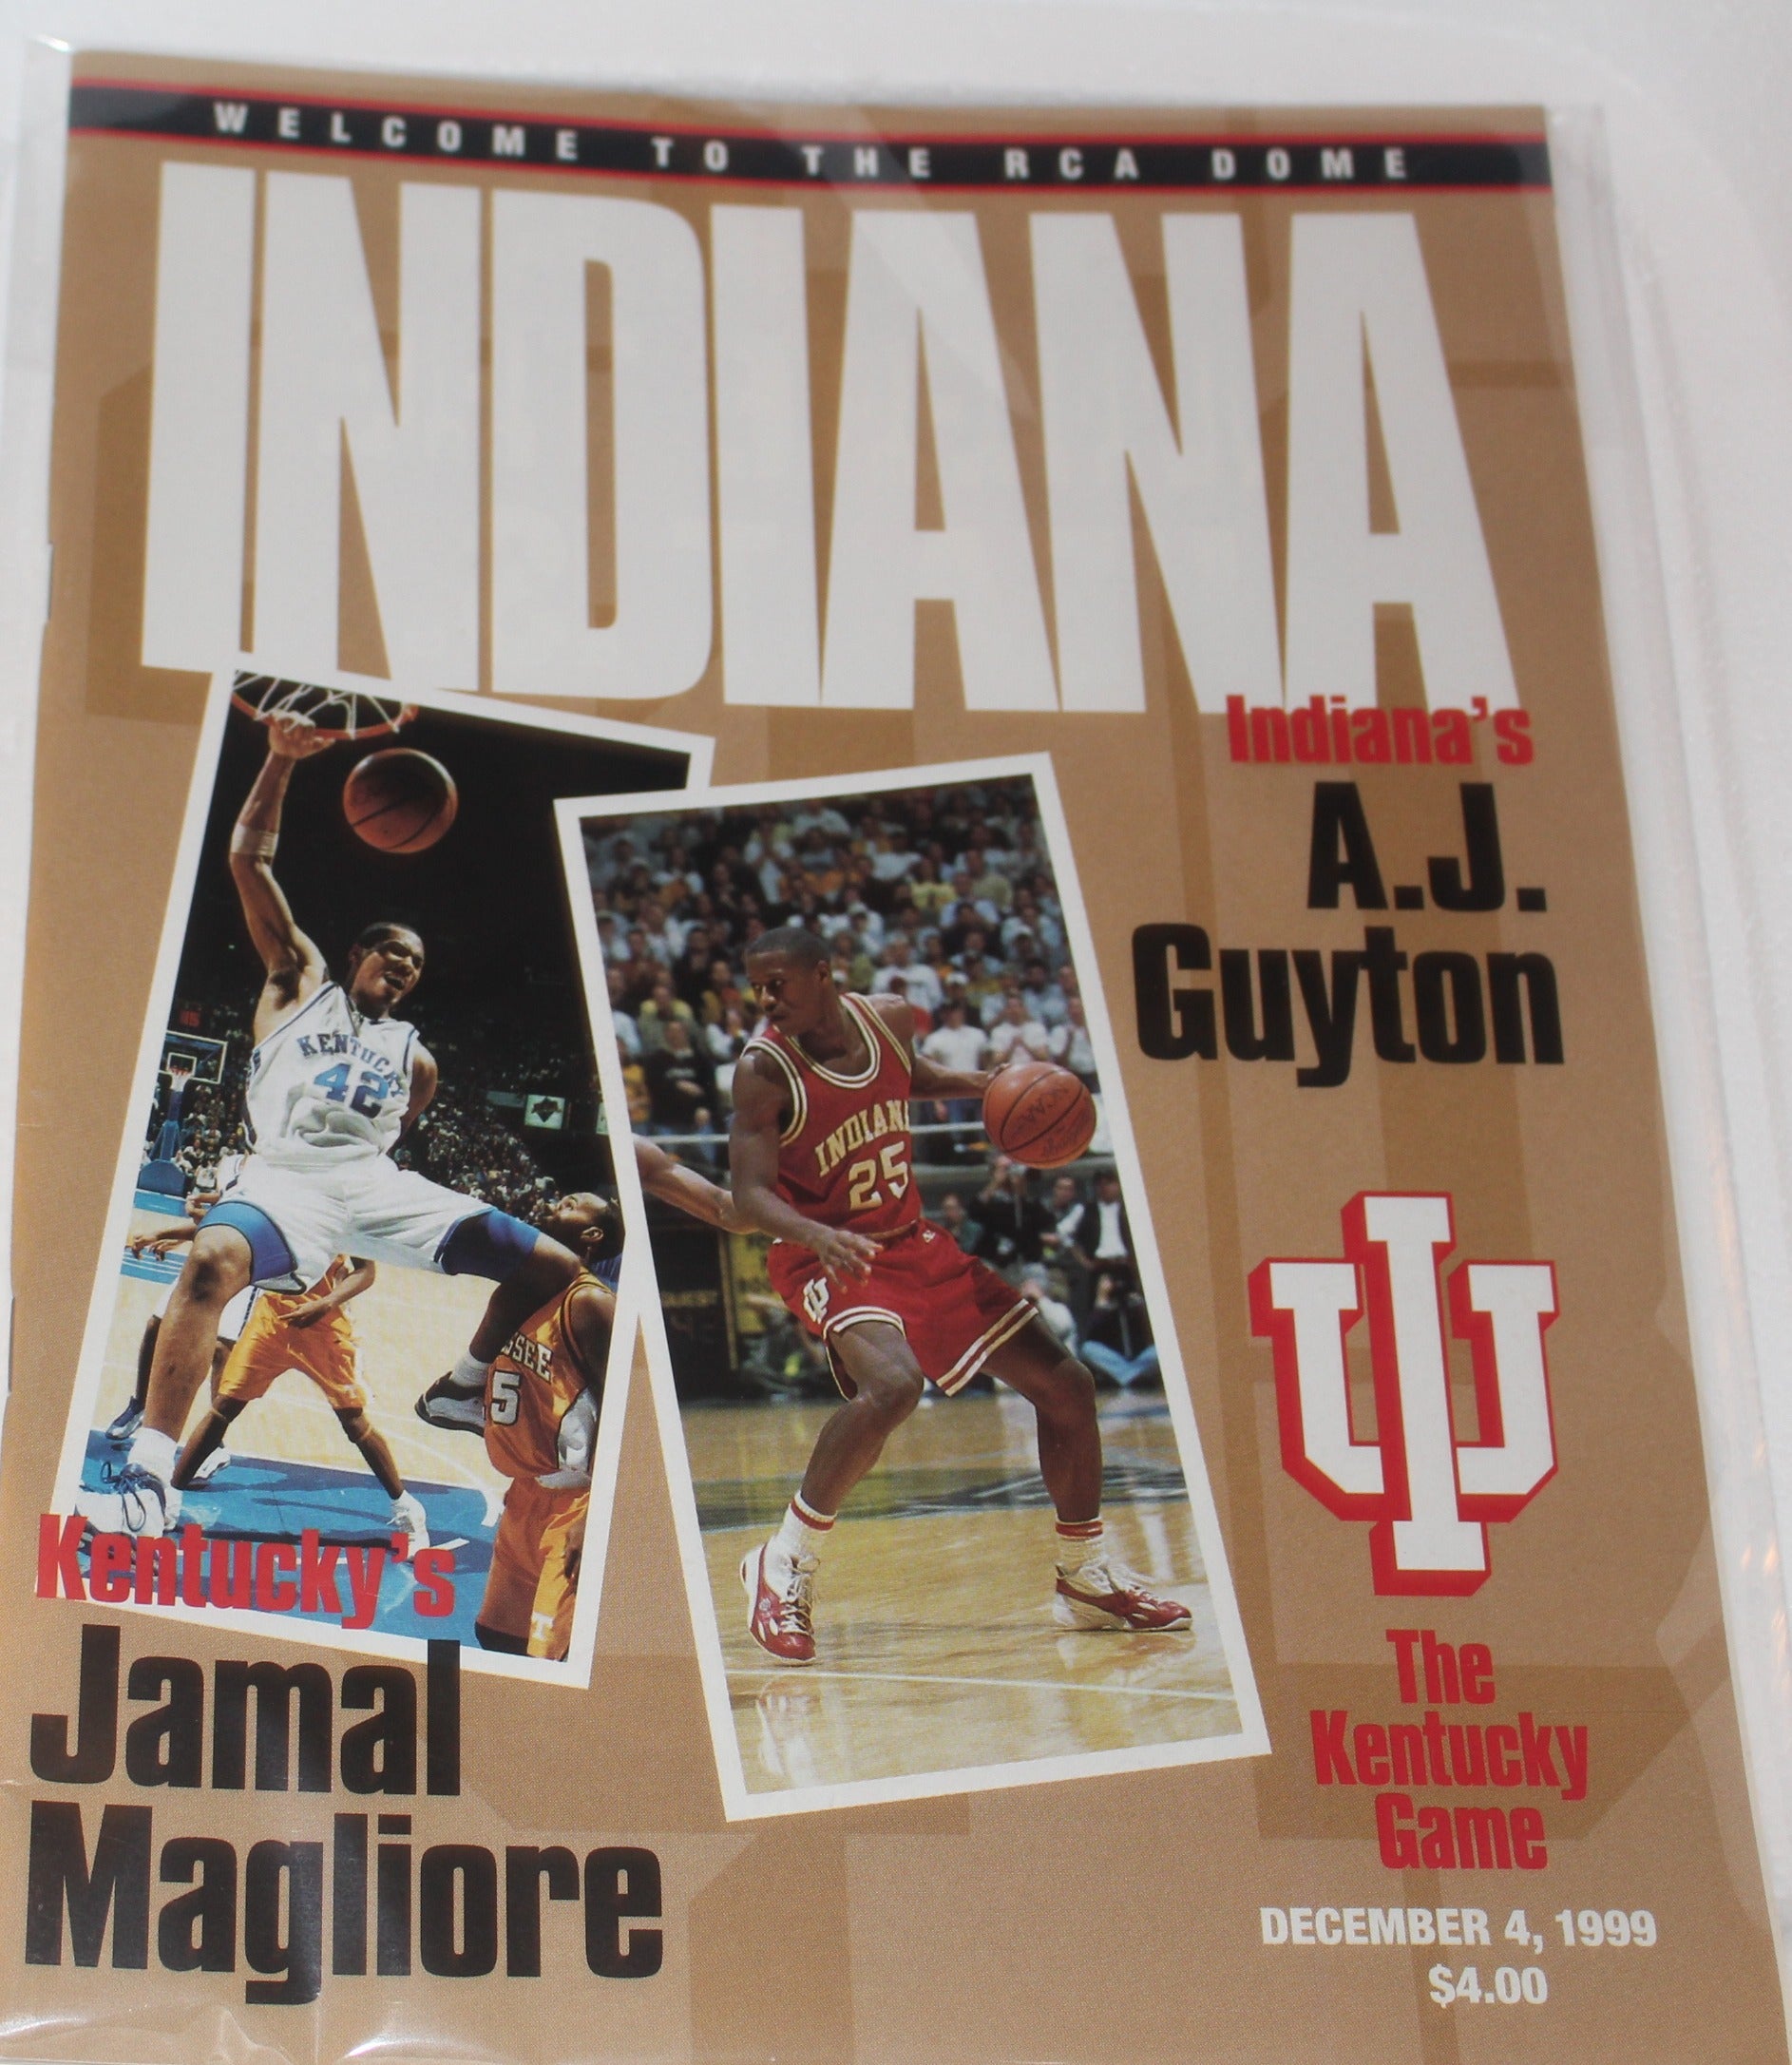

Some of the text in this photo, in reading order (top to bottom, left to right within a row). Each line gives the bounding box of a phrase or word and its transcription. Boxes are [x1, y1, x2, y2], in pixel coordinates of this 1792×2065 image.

[216, 104, 1402, 178] WELCOME TO THE RCA DOME
[142, 160, 1520, 715] INDIANA
[1228, 696, 1534, 765] Indiana's
[1307, 781, 1547, 912] A.J.
[1132, 923, 1564, 1088] Guyton
[314, 1061, 389, 1119] 42
[848, 1140, 909, 1211] 25
[36, 1513, 454, 1630] Kentucky's
[1386, 1629, 1496, 1705] The
[30, 1625, 462, 1796] Jamal
[1310, 1711, 1589, 1802] Kentucky
[1375, 1792, 1548, 1870] Game
[26, 1800, 663, 2005] Magliore
[1259, 1904, 1658, 1956] DECEMBER 4, 1999
[1428, 1963, 1550, 2009] $4.00
